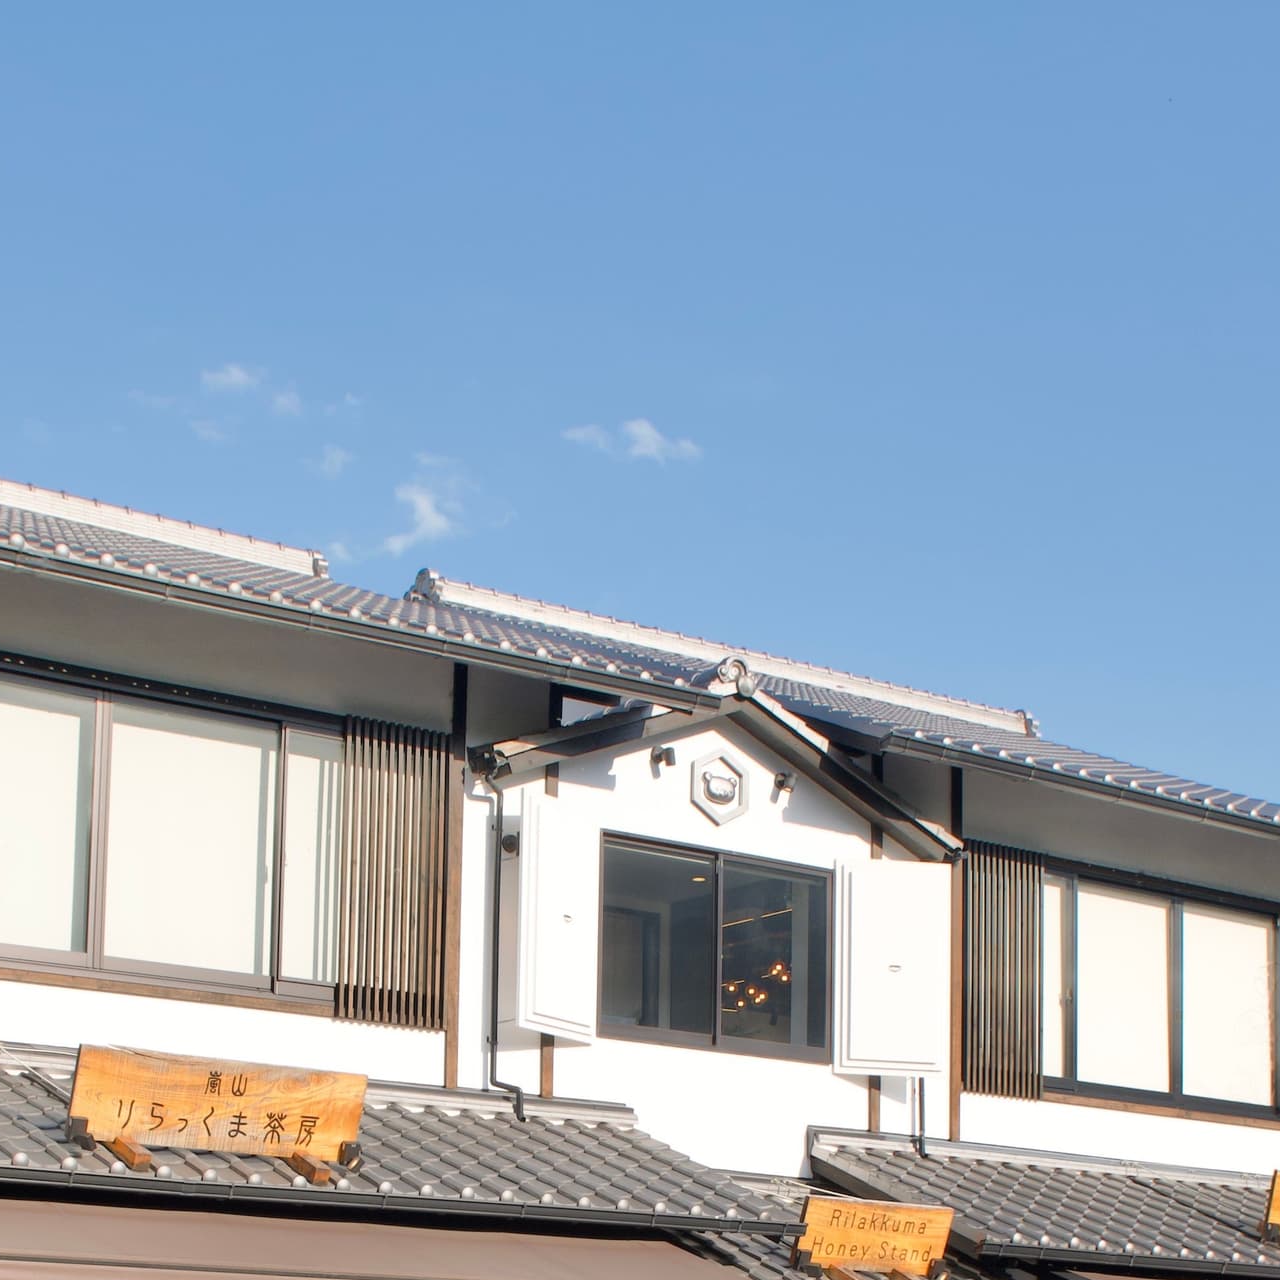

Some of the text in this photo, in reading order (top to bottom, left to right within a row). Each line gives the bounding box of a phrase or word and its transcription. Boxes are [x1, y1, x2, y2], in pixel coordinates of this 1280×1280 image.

[205, 1071, 248, 1096] 嵐山
[118, 1099, 320, 1147] りらっくま茶房
[829, 1209, 927, 1235] Rilakkuma
[812, 1236, 932, 1262] Honey Stand
